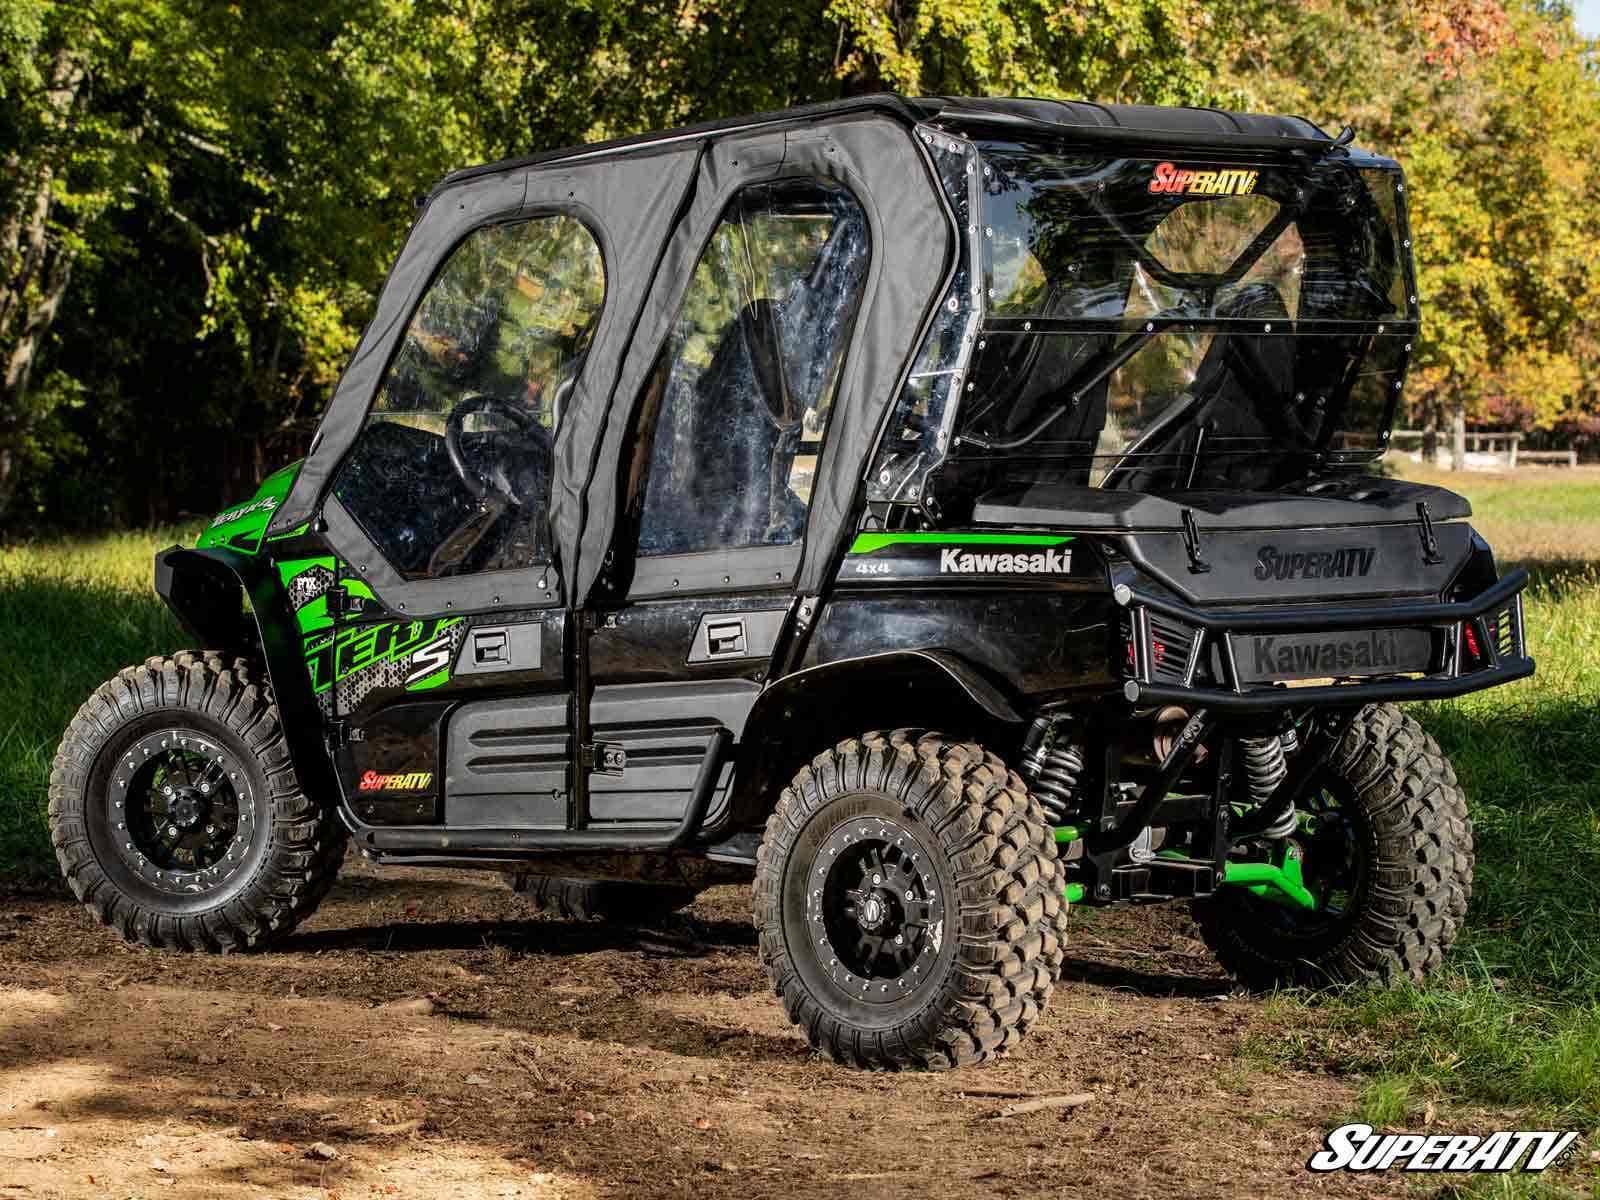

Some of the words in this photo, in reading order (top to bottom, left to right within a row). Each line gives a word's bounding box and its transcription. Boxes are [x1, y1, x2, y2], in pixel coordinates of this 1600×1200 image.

[1149, 162, 1253, 194] SUPERATV
[855, 562, 891, 574] 4x4
[940, 548, 1072, 573] Kawasaki
[1254, 544, 1376, 581] SUPERATV
[1254, 629, 1400, 675] Kawasaki
